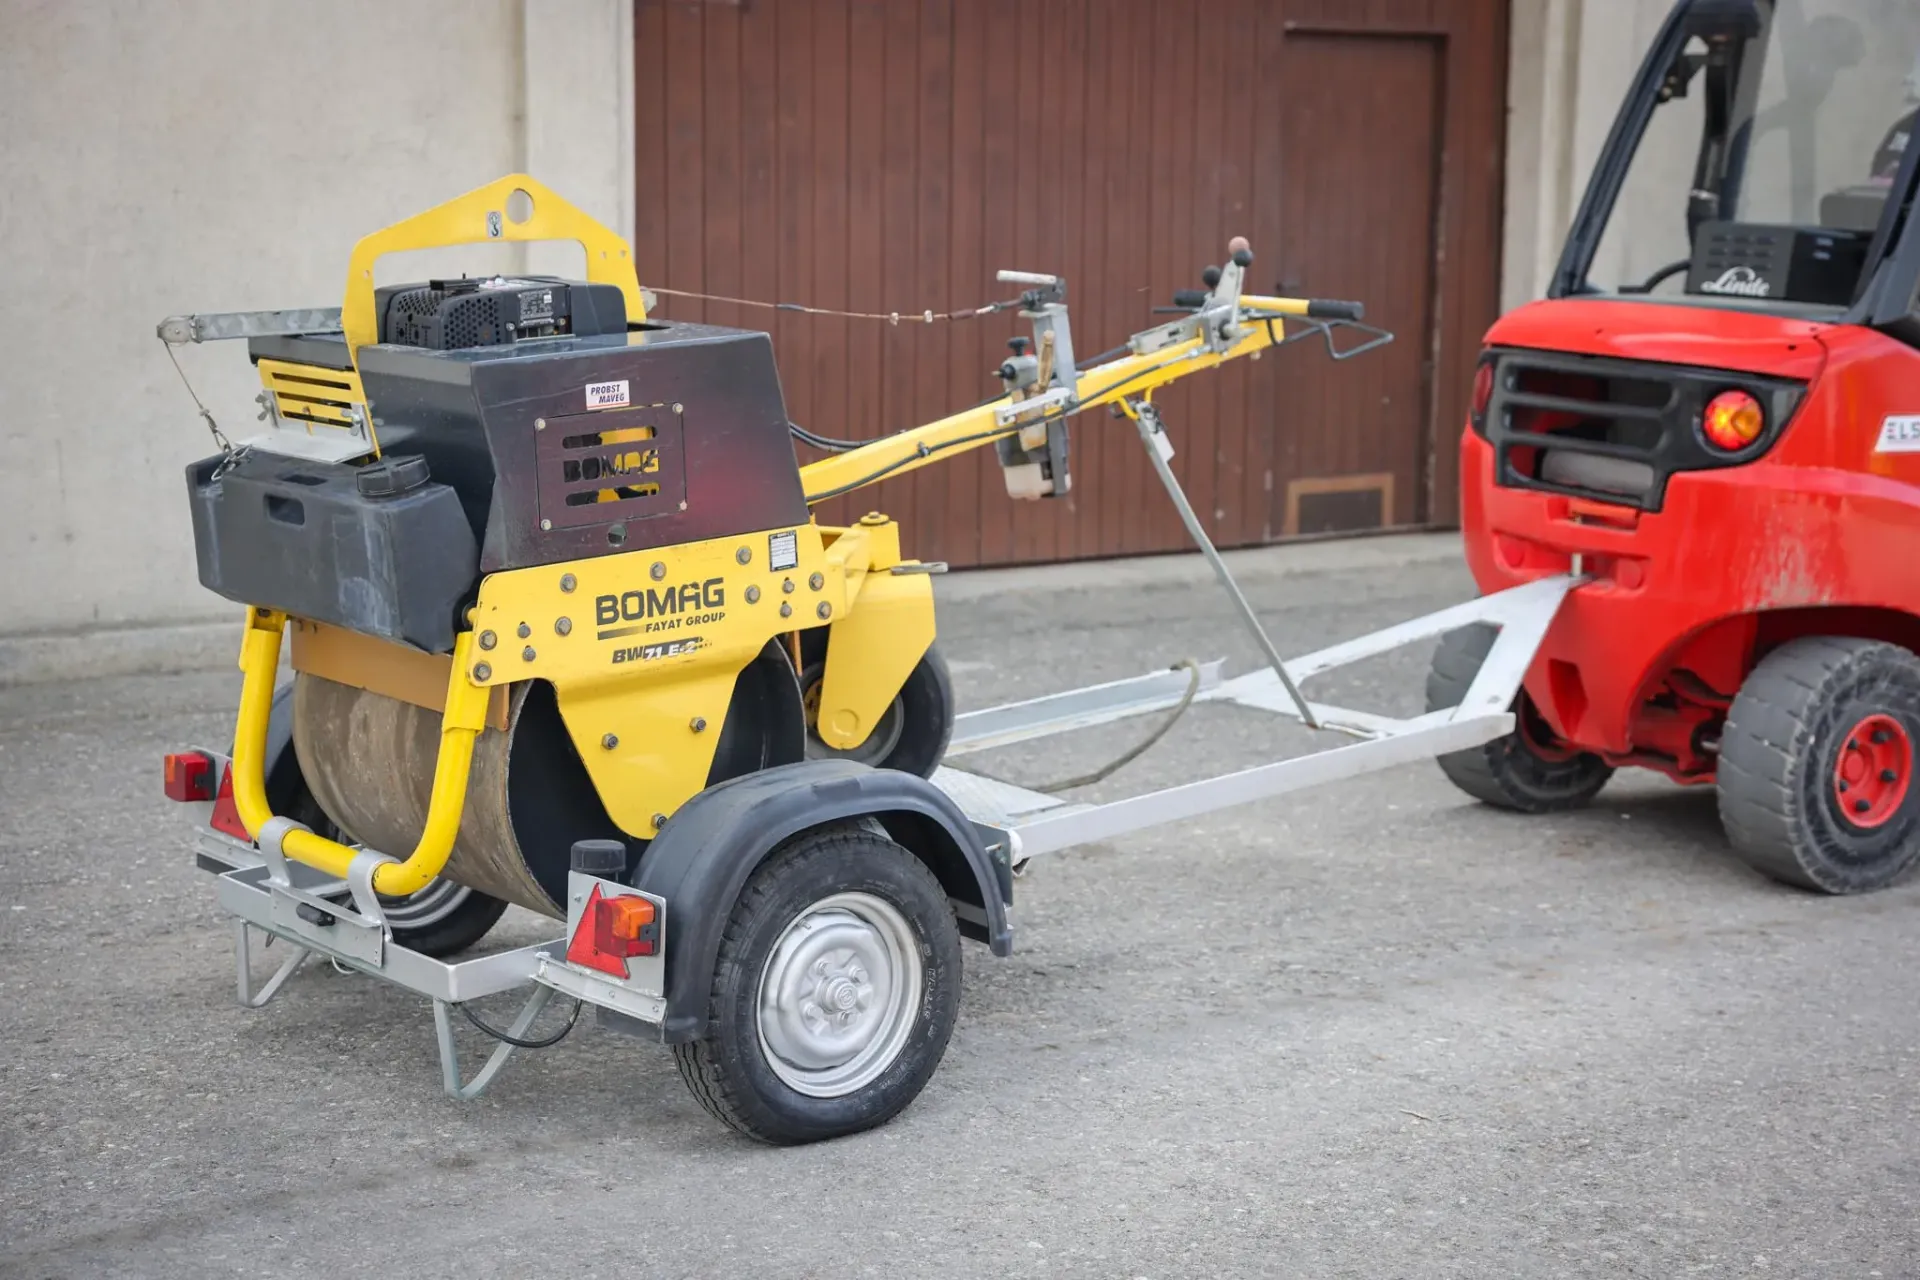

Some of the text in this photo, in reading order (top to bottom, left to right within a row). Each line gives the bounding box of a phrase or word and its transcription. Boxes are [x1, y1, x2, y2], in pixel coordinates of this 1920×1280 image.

[1701, 266, 1770, 297] Linde
[590, 384, 621, 395] PROBST
[598, 394, 625, 404] MAVEG
[596, 577, 725, 626] BOMAG
[645, 611, 726, 633] FAYAT GROUP
